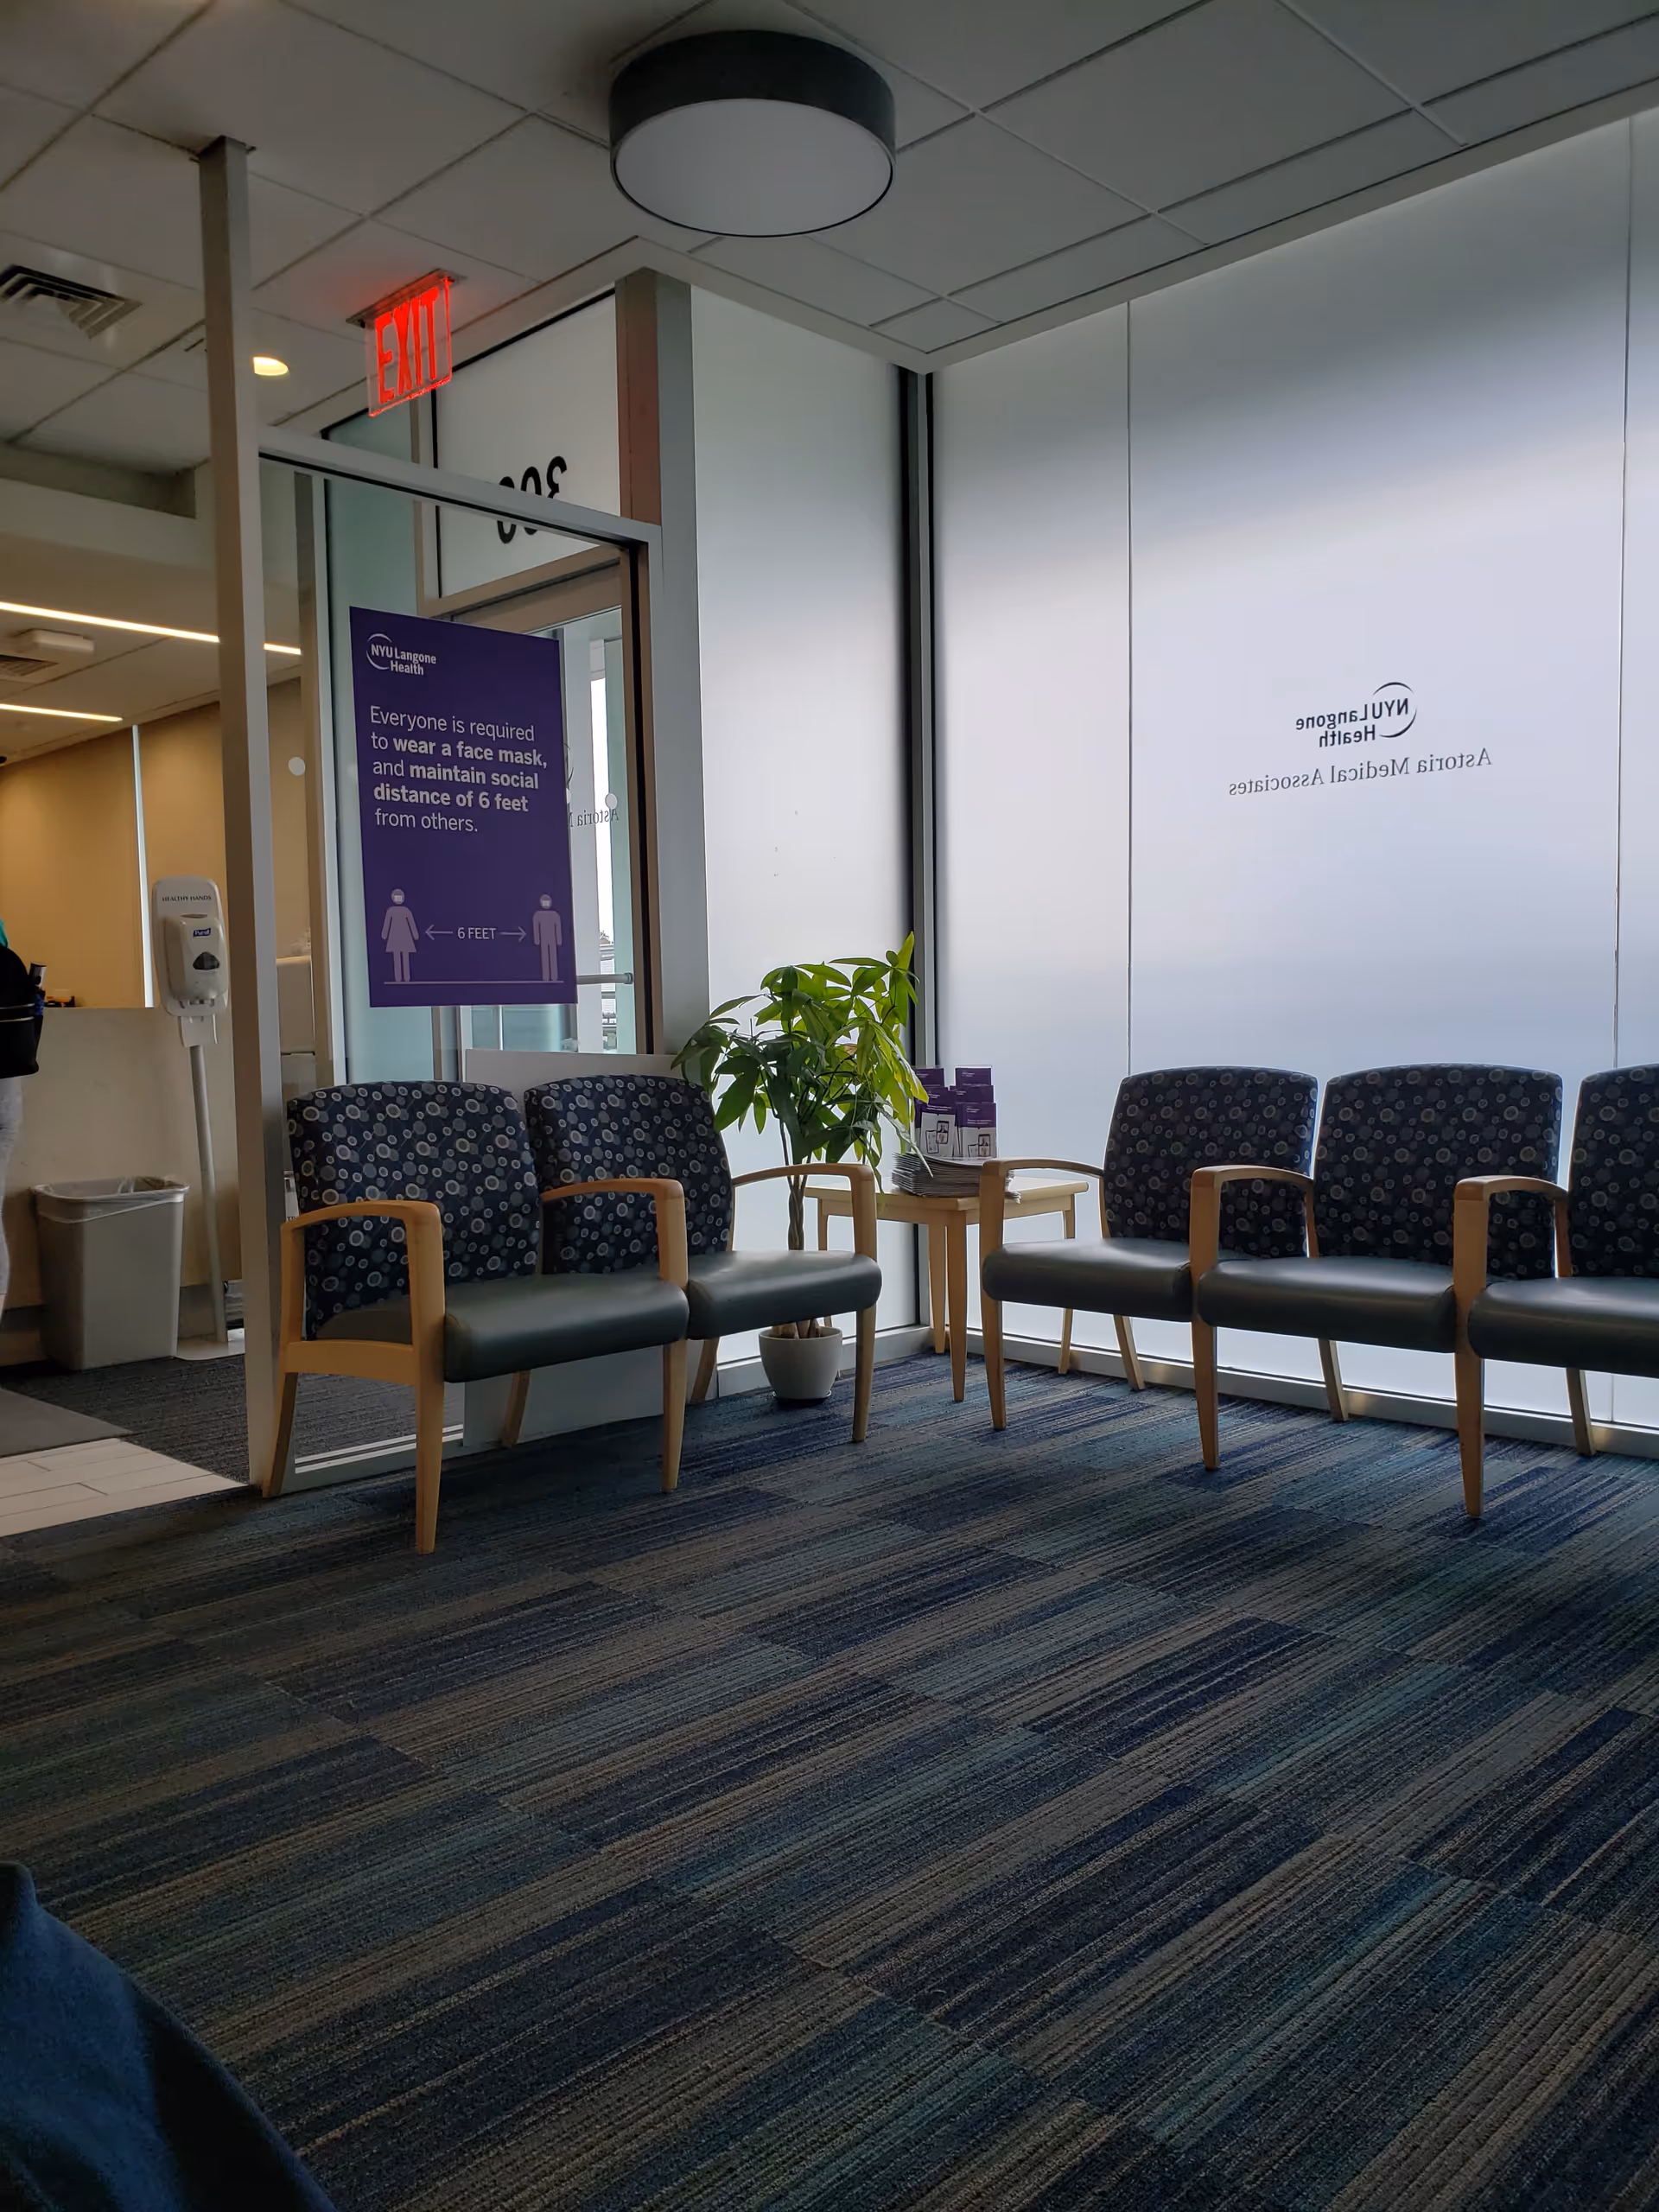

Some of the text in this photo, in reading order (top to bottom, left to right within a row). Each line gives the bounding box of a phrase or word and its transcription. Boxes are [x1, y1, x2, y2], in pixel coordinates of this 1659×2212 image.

[375, 286, 439, 404] EXIT
[371, 643, 437, 664] NYU Langone
[390, 659, 424, 676] Health
[370, 705, 535, 741] Everyone is required
[371, 732, 548, 769] to wear a face mask,
[372, 760, 539, 790] and maintain social
[373, 783, 529, 812] distance of 6 feet
[374, 808, 478, 832] from others.
[457, 927, 497, 940] 6 FEET
